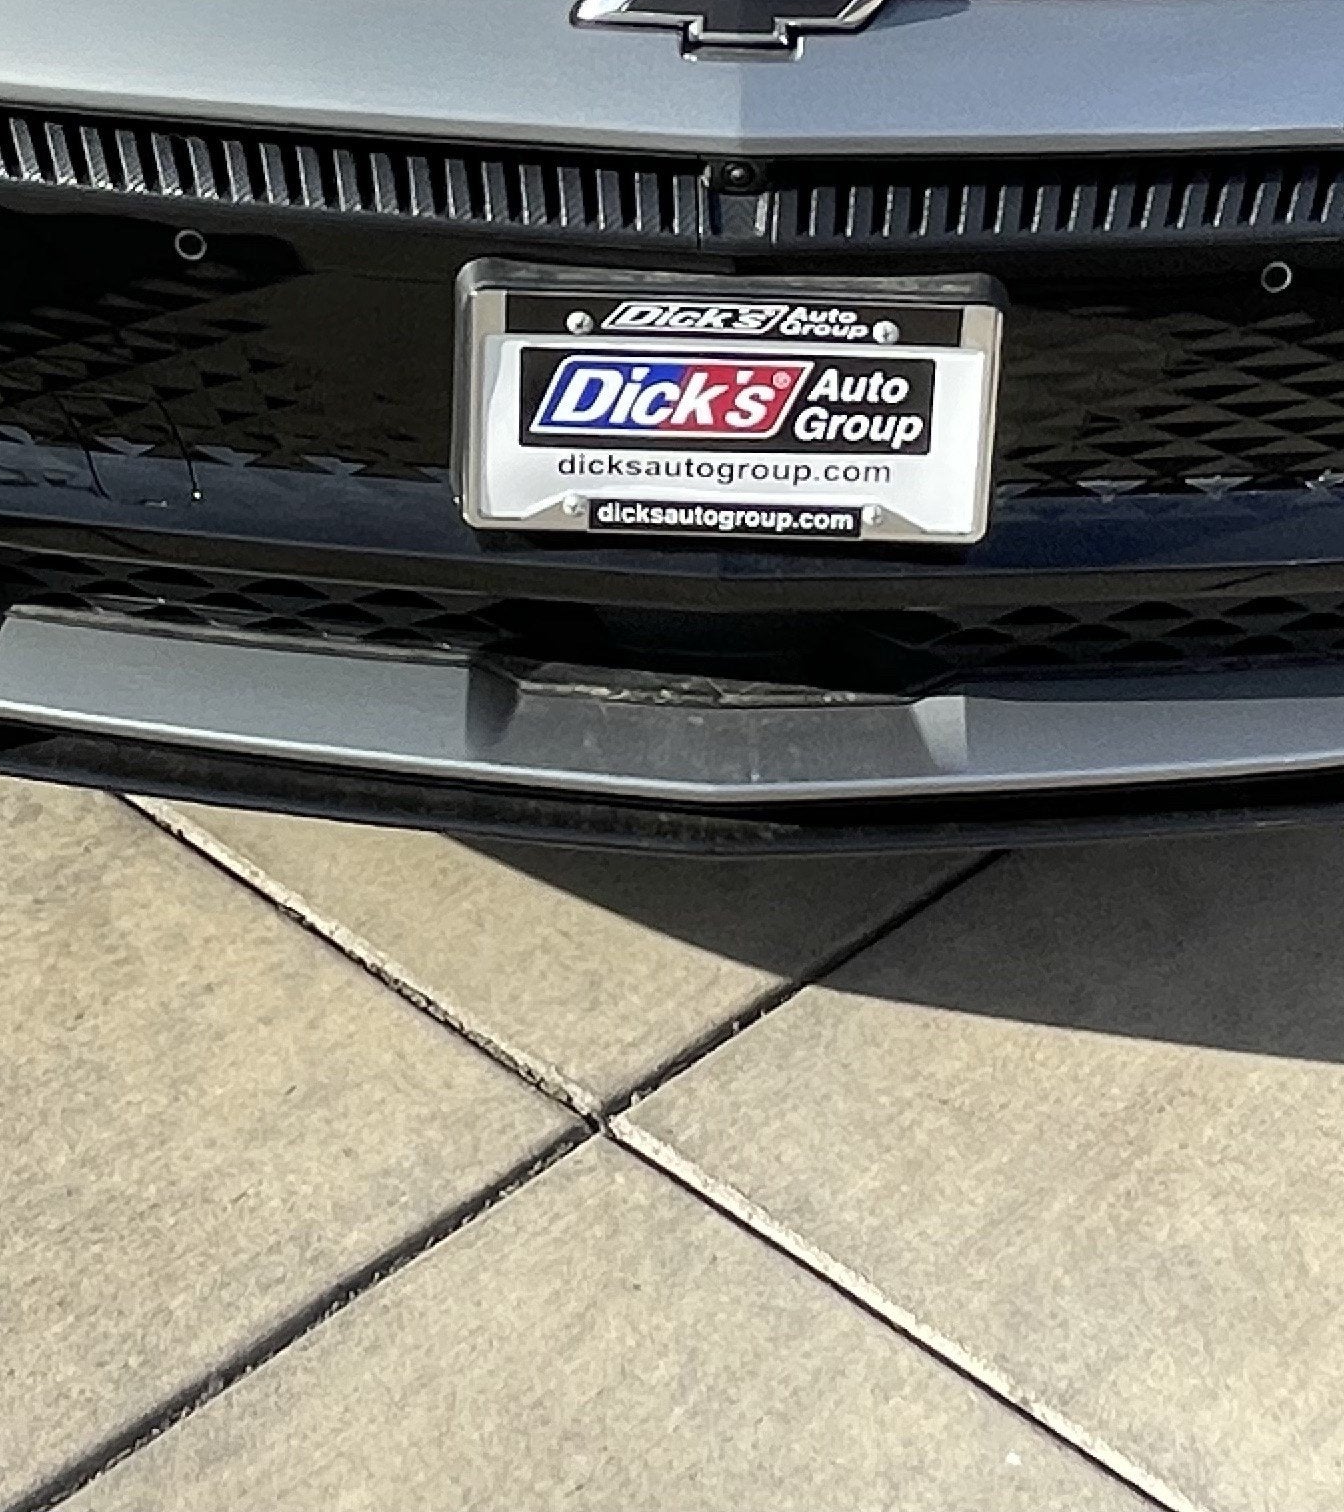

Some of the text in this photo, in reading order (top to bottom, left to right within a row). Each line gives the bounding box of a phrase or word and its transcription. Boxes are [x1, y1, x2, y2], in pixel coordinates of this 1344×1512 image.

[779, 319, 869, 340] Group
[783, 306, 858, 325] Auto
[551, 367, 775, 428] Dick's
[806, 369, 909, 404] Auto
[794, 406, 923, 448] Group
[557, 453, 892, 486] dicksautogroup.com
[597, 501, 854, 532] dicksautogroup.com
